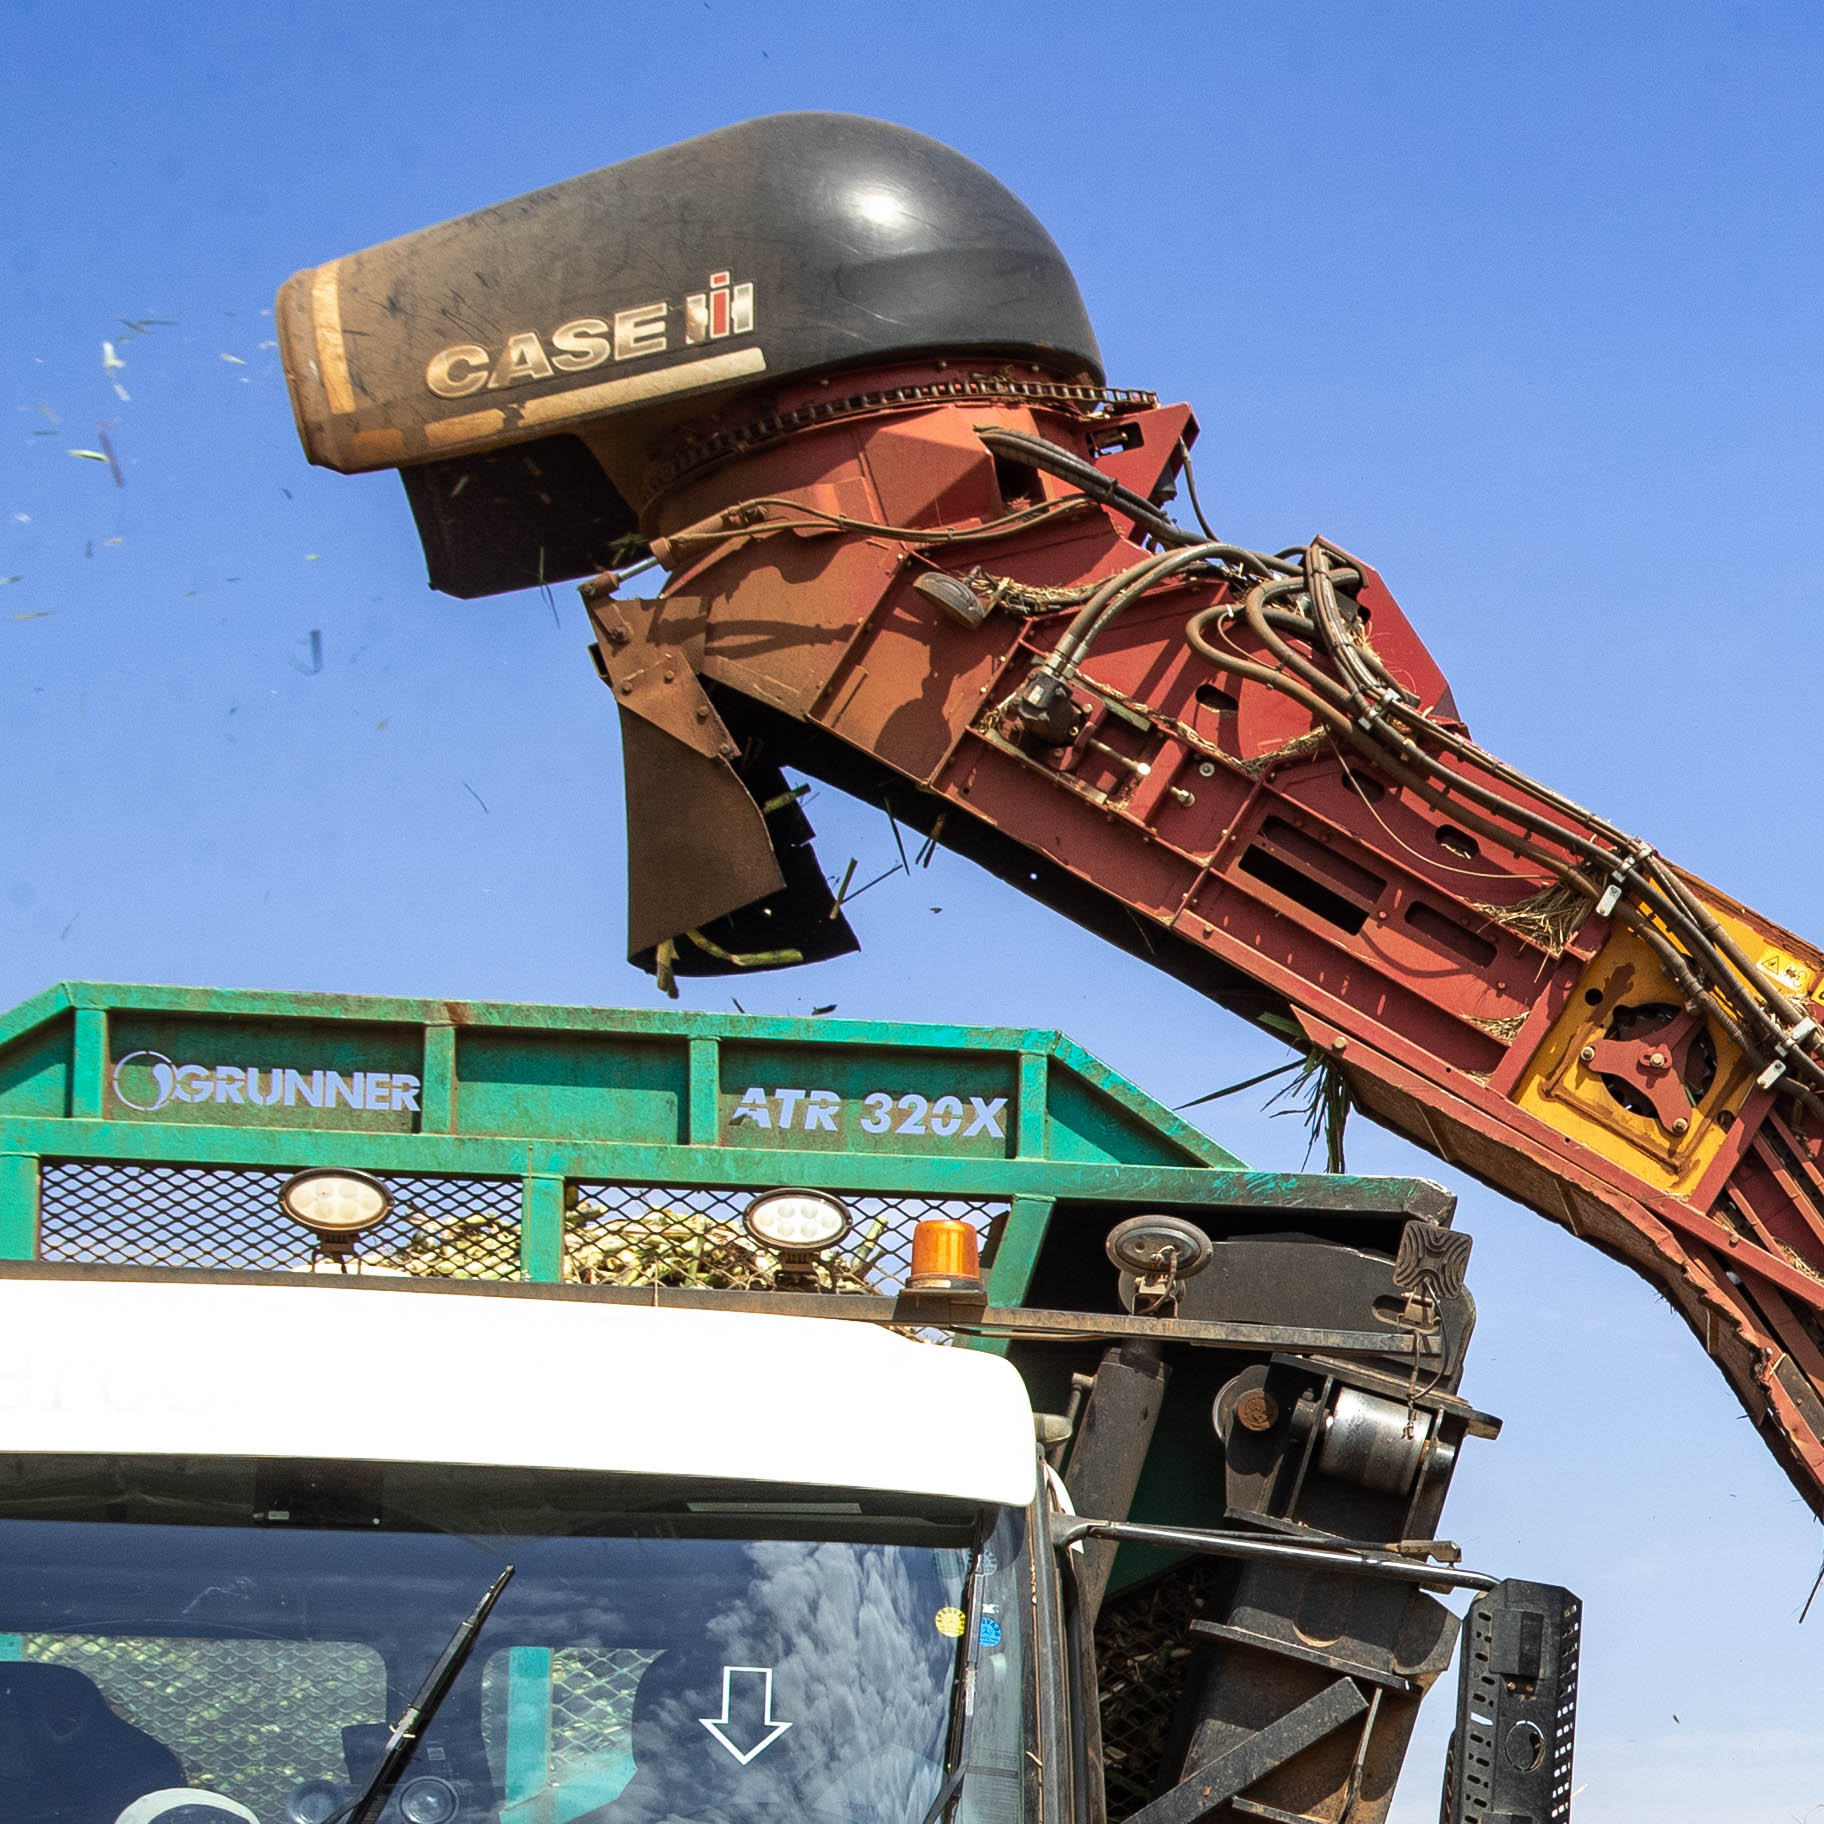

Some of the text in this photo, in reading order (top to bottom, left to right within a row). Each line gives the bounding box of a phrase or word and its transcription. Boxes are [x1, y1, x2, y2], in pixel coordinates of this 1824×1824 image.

[425, 302, 668, 400] CASE
[171, 1064, 422, 1113] GRUNNER
[729, 1087, 1008, 1139] ATR 320X
